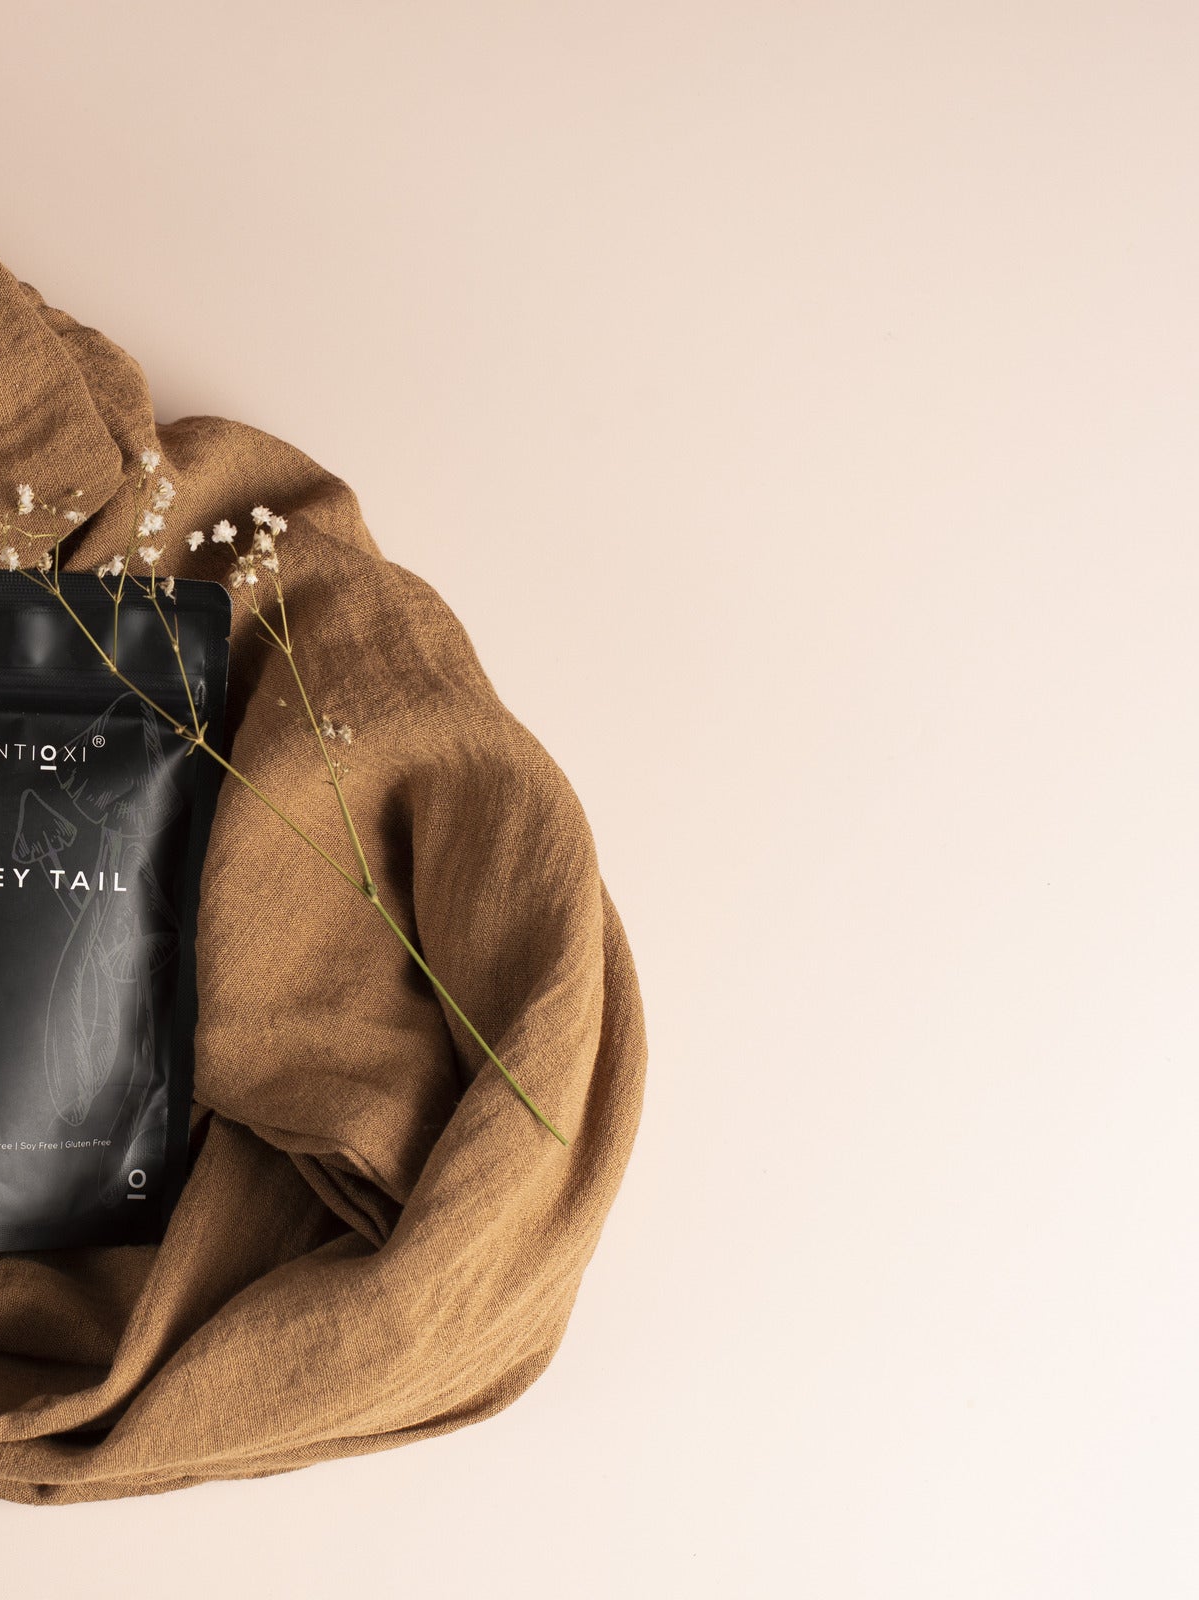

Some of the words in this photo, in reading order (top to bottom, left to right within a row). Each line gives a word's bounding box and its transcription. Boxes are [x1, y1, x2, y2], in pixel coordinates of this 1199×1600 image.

[49, 869, 127, 892] TAIL
[20, 1142, 37, 1151] Soy
[65, 1140, 91, 1149] Gluten
[92, 1139, 112, 1147] Free
